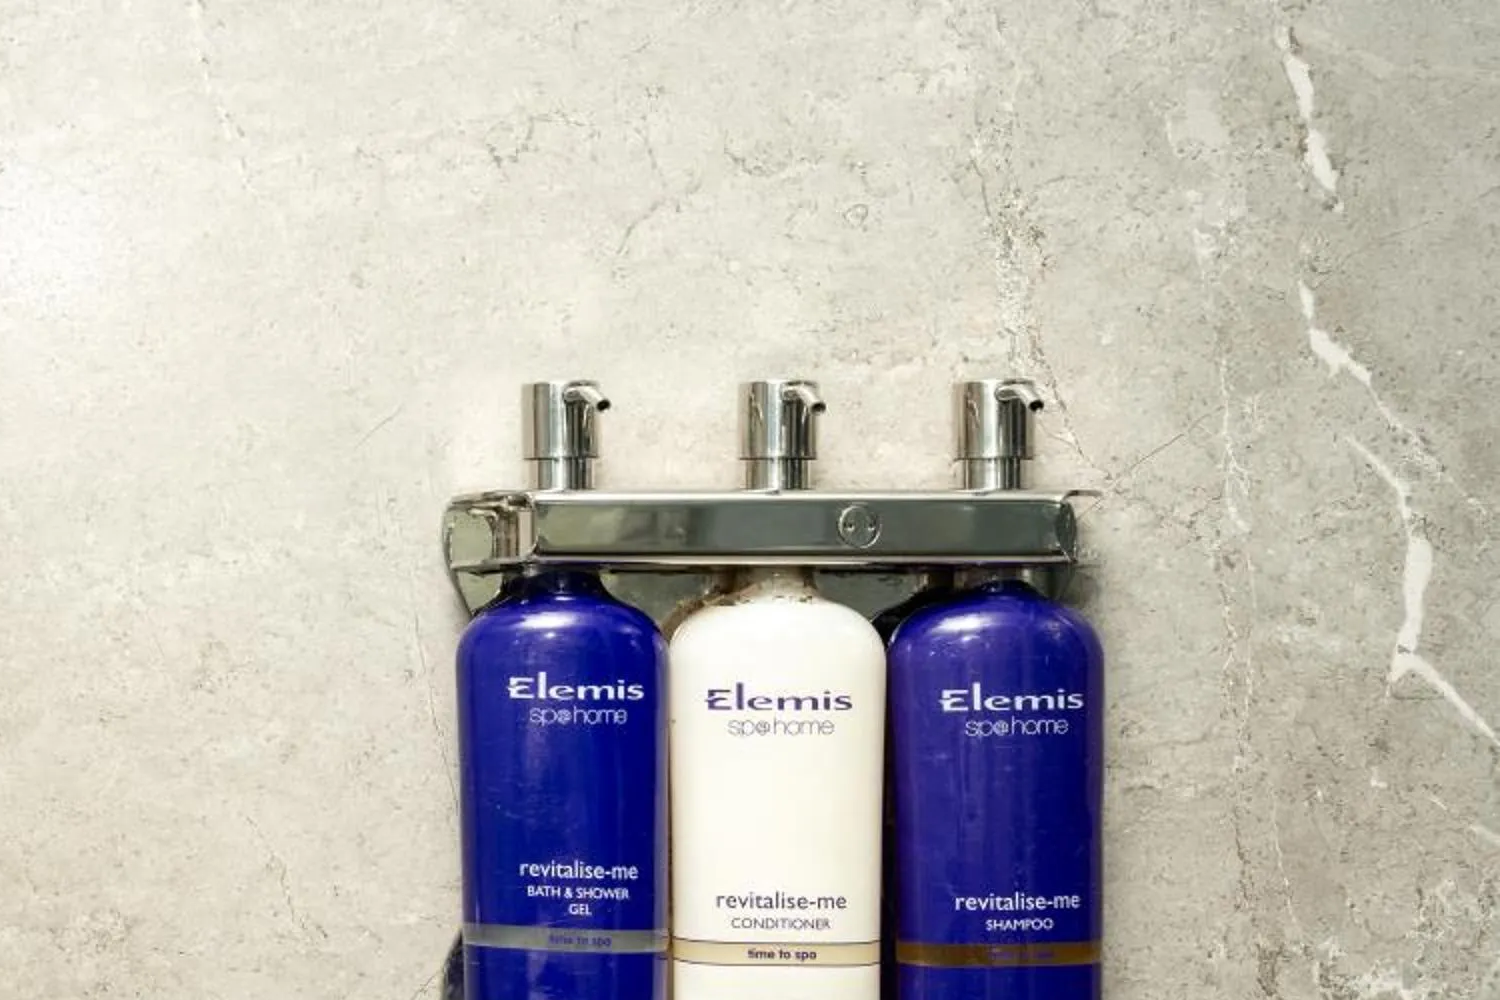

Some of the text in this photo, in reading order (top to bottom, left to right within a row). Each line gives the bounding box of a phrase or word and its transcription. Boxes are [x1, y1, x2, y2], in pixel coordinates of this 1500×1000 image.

[508, 671, 645, 700] Elemis
[705, 682, 853, 711] Elemis
[939, 682, 1085, 711] Elemis
[519, 860, 639, 880] revitalise-me
[527, 885, 629, 900] BATH & SHOWER
[716, 890, 848, 910] revitalise-me
[955, 891, 1081, 911] revitalise-me
[568, 903, 592, 916] GEL
[731, 917, 831, 931] CONDITIONER
[985, 917, 1054, 931] SHAMPOO
[747, 948, 775, 960] time
[779, 949, 791, 960] to
